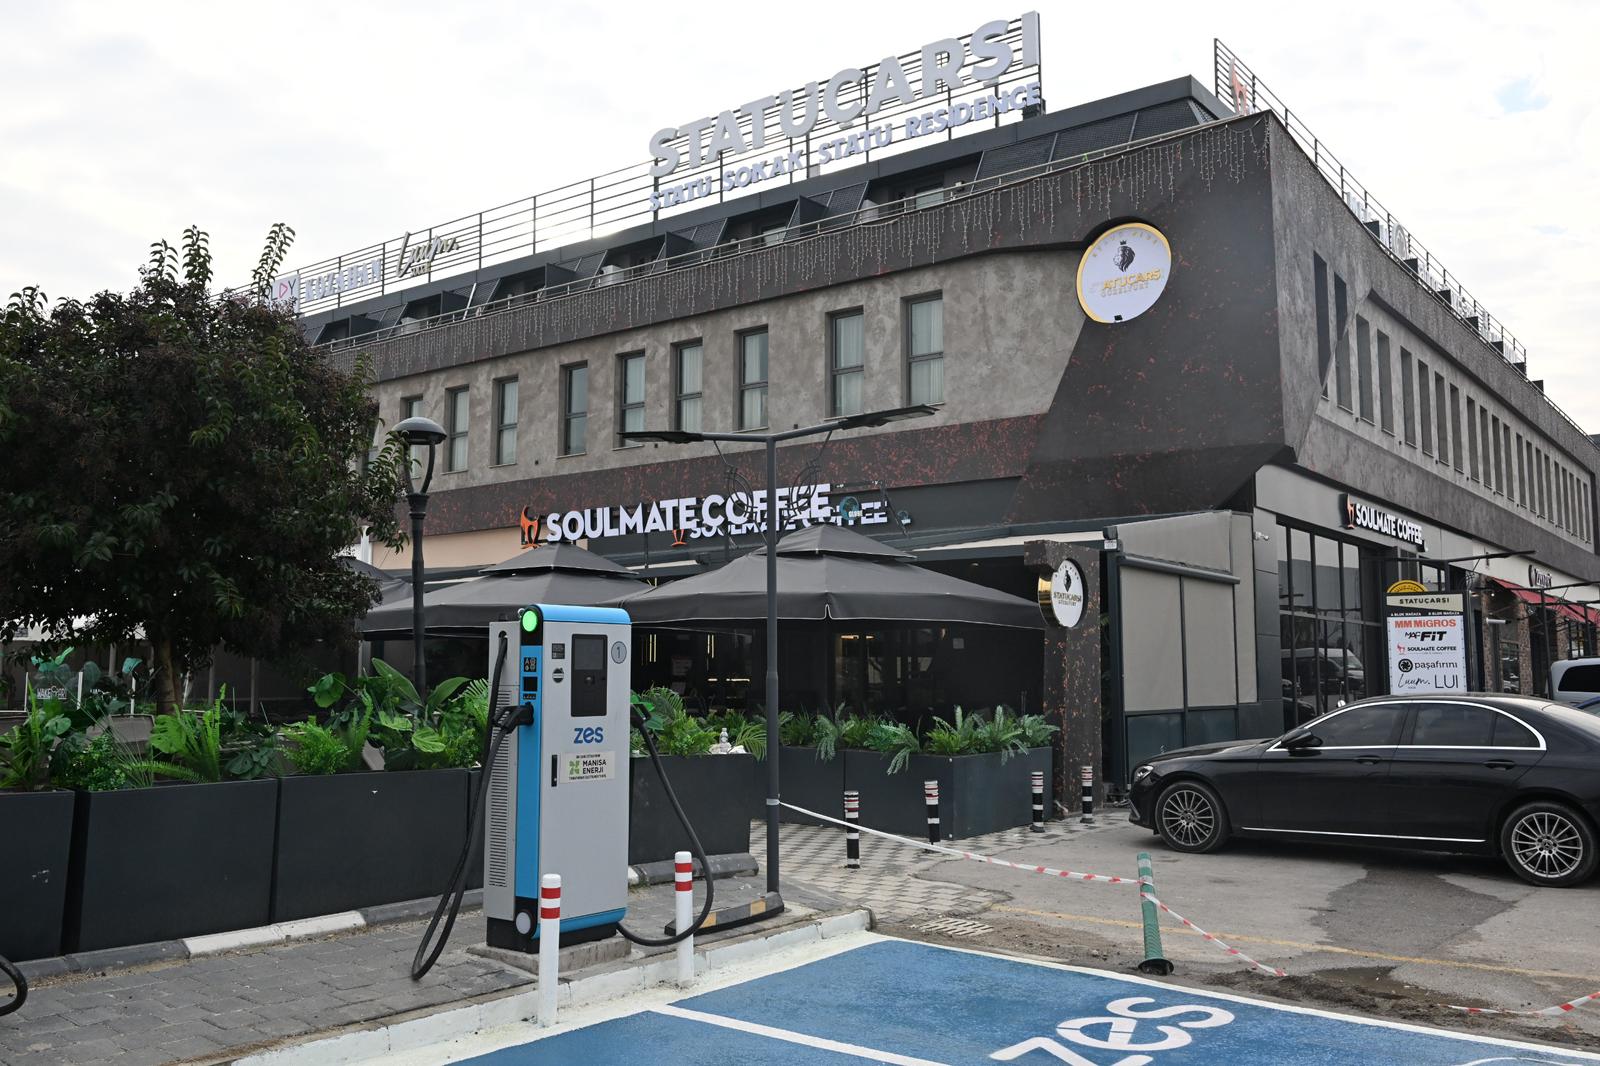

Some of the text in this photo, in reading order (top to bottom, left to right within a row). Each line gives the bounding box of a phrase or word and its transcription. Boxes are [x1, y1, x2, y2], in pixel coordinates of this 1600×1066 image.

[722, 149, 804, 192] SOKAK
[905, 82, 1041, 139] RESIDENCE
[545, 484, 831, 542] SOULMATE COFFEE
[1356, 503, 1423, 545] SOULMATE COFFEE
[1434, 674, 1459, 688] LUI
